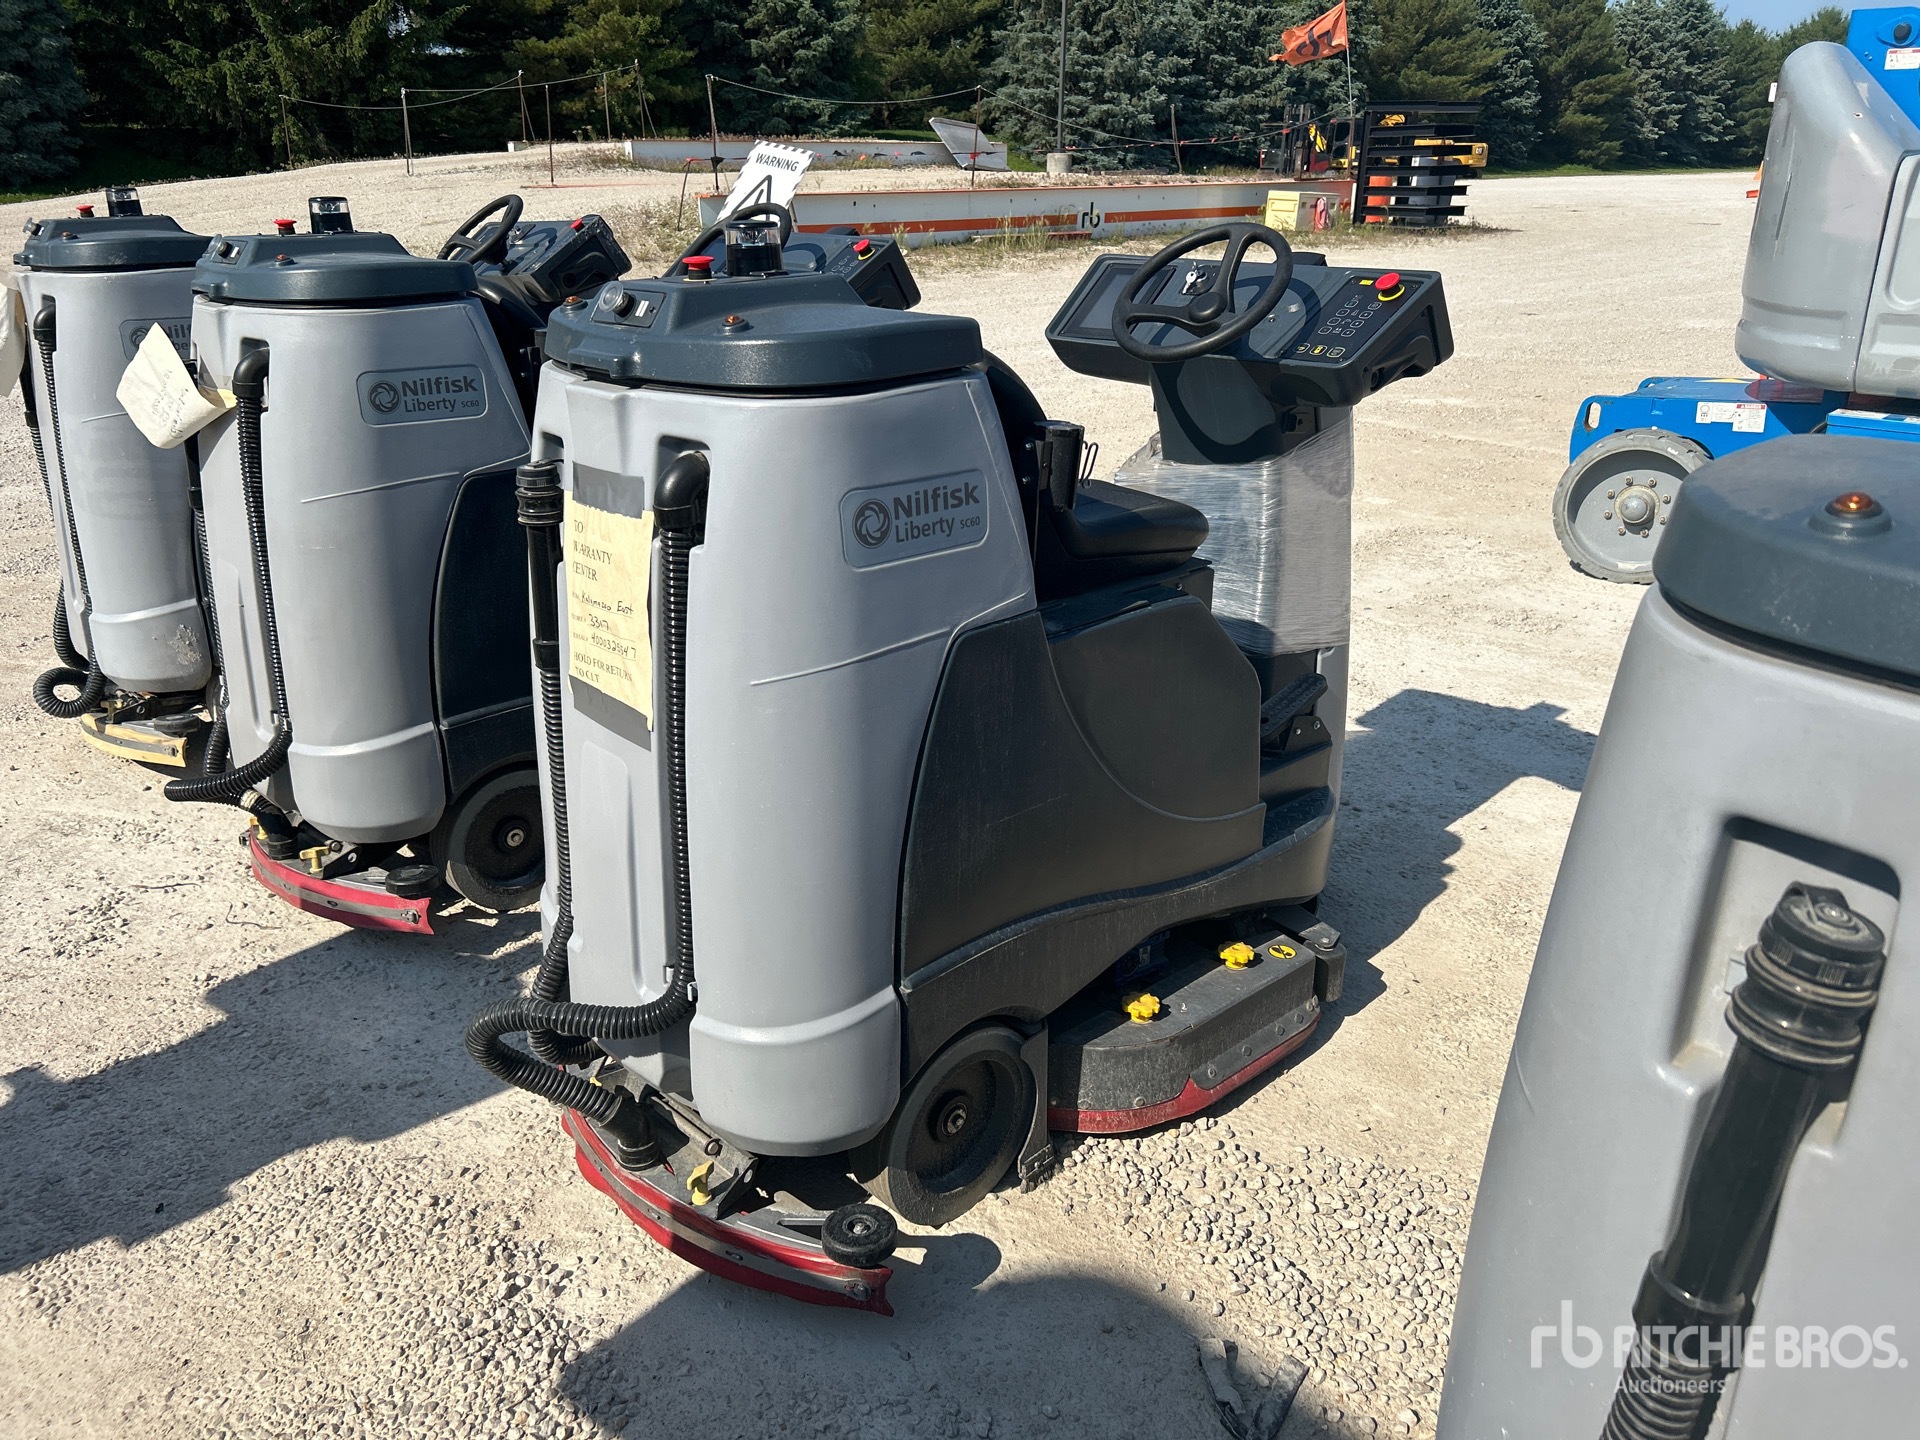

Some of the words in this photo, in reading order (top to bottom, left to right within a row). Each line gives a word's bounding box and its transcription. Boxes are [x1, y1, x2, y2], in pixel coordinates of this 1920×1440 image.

[755, 153, 799, 171] WARNING
[1081, 201, 1100, 228] rb
[401, 376, 478, 397] Nilfisk
[403, 398, 457, 413] Liberty
[461, 400, 480, 408] SC60
[893, 482, 980, 520] Nilfisk
[574, 519, 584, 533] TO
[895, 516, 955, 543] Liberty
[960, 516, 980, 529] SC60
[573, 539, 613, 565] WARRANTY
[573, 561, 597, 581] CENTER
[574, 651, 592, 666] HOLD
